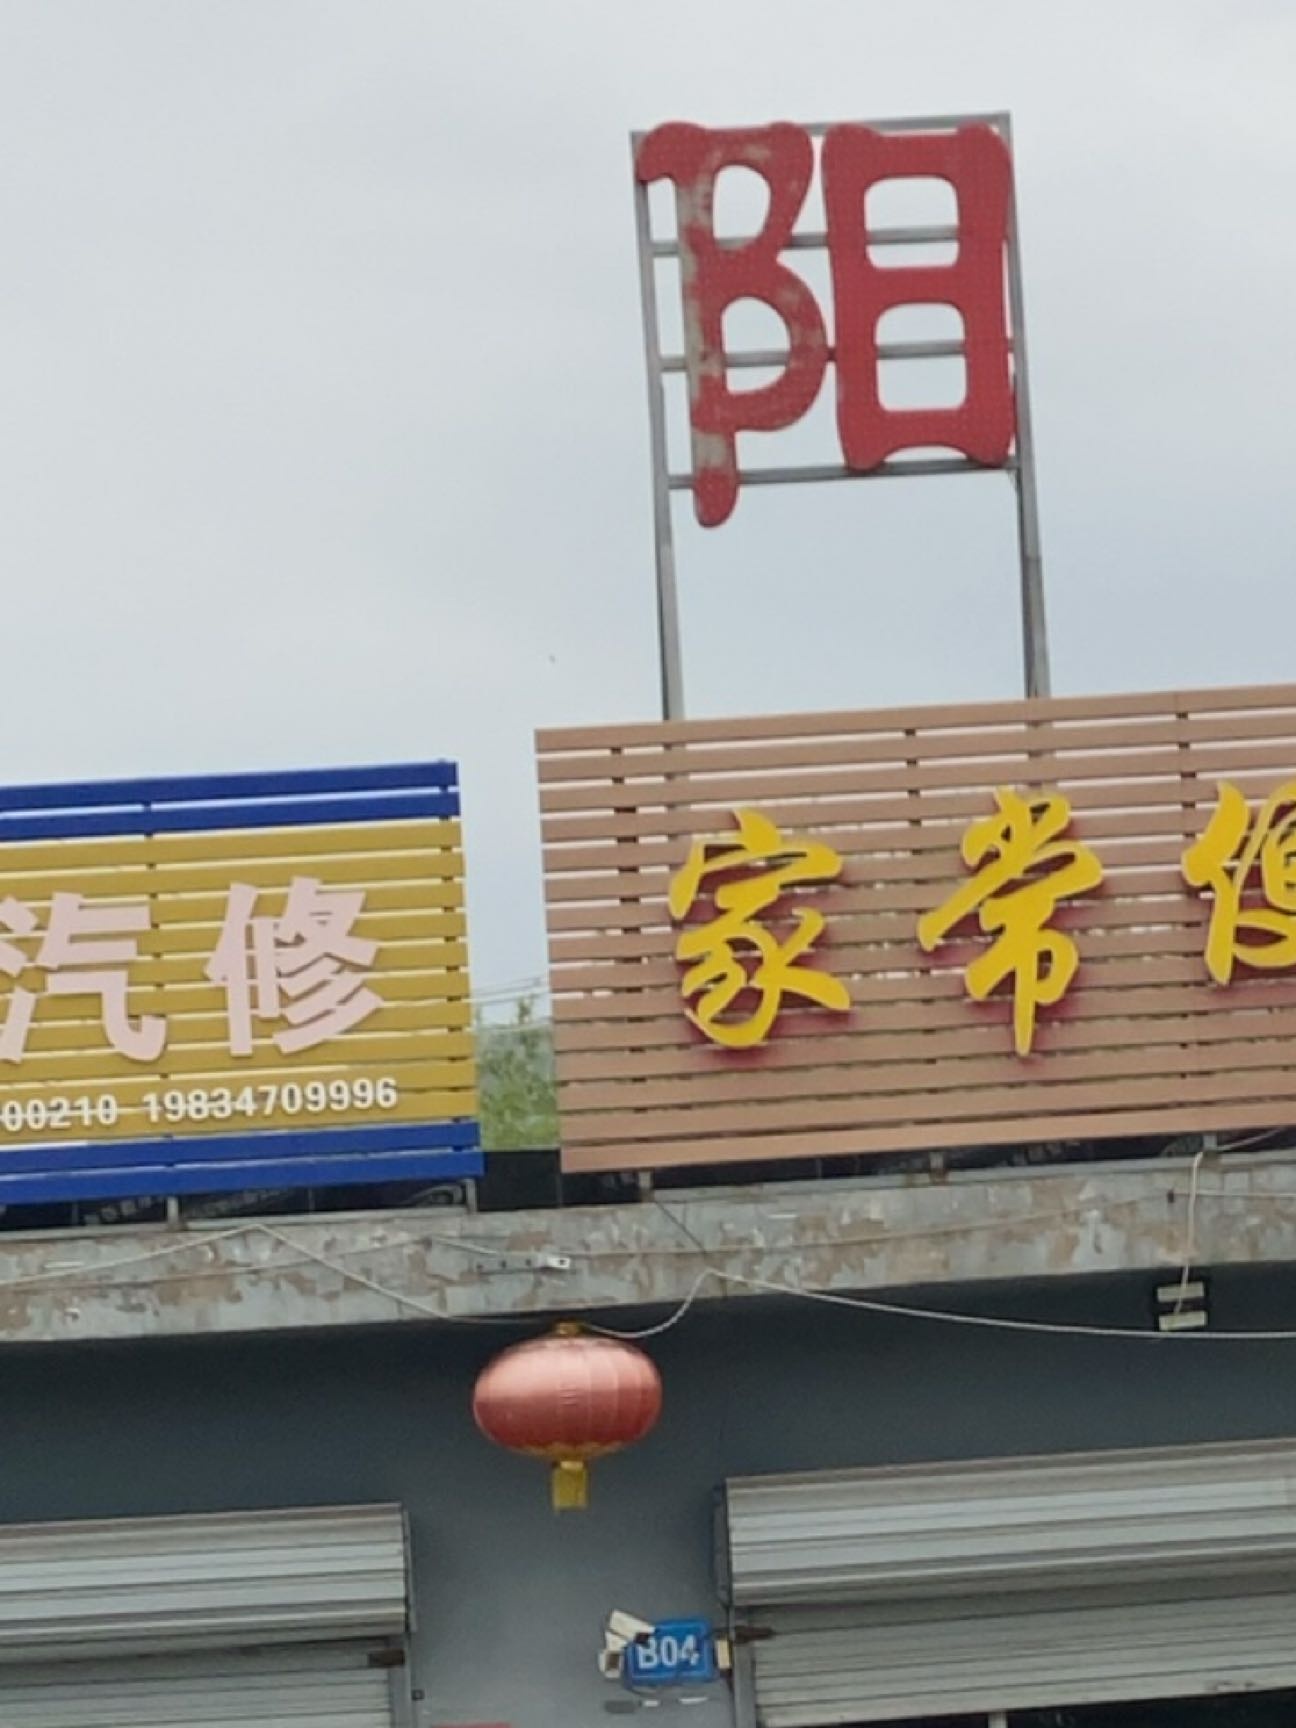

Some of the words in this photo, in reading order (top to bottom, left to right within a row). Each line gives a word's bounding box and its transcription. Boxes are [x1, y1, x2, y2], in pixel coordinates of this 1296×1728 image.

[636, 121, 1016, 527] 阳
[0, 876, 384, 1062] 汽修
[142, 1078, 398, 1123] 19834709996
[636, 1634, 700, 1669] B04
